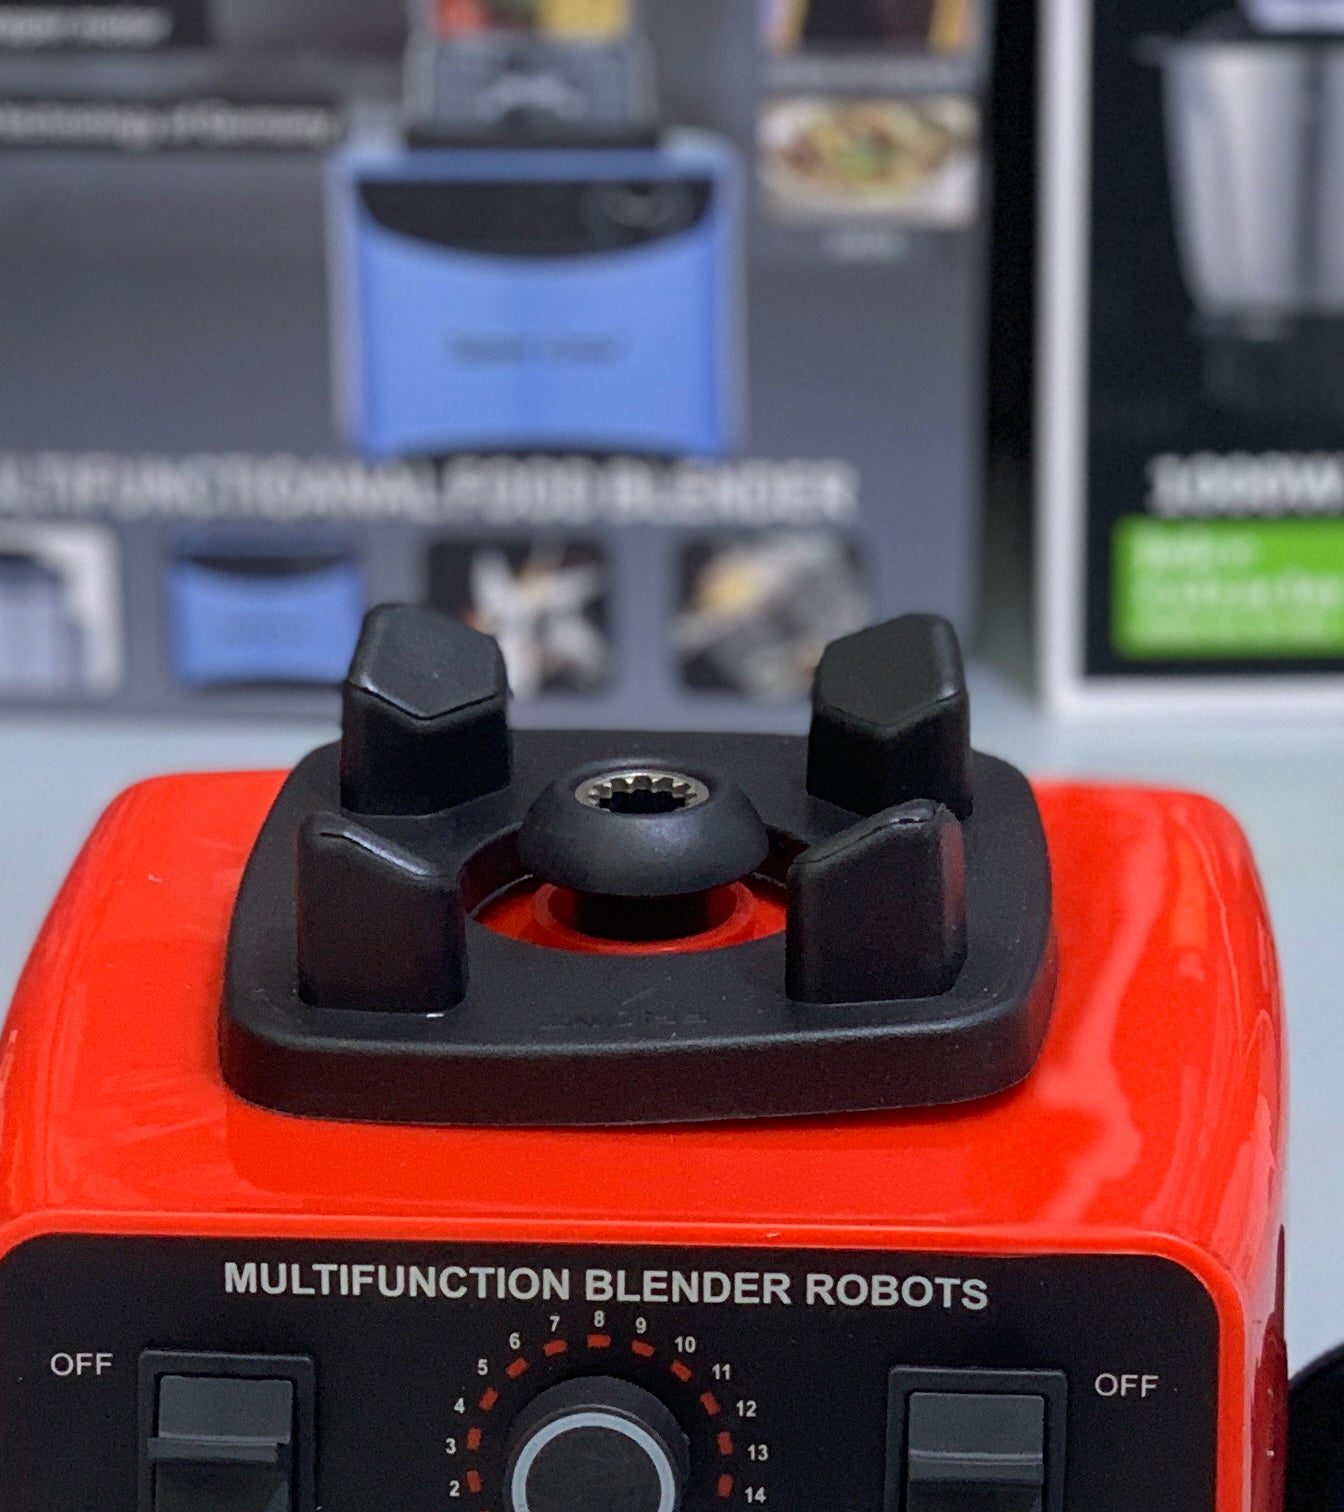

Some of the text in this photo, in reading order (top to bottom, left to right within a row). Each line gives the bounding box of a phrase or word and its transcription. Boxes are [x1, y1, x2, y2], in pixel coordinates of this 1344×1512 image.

[225, 1263, 989, 1311] MULTIFUNCTION BLENDER ROBOTS
[550, 1316, 561, 1333] 7
[594, 1311, 606, 1329] 8
[636, 1318, 648, 1335] 9
[510, 1333, 522, 1351] 6
[676, 1337, 697, 1354] 10
[51, 1353, 114, 1377] OFF
[478, 1359, 489, 1377] 5
[713, 1364, 731, 1381] 11
[1095, 1374, 1160, 1399] OFF
[455, 1398, 466, 1415] 4
[737, 1401, 758, 1418] 12
[447, 1438, 458, 1455] 3
[749, 1445, 770, 1462] 13
[450, 1481, 461, 1498] 2
[746, 1487, 768, 1504] 14
